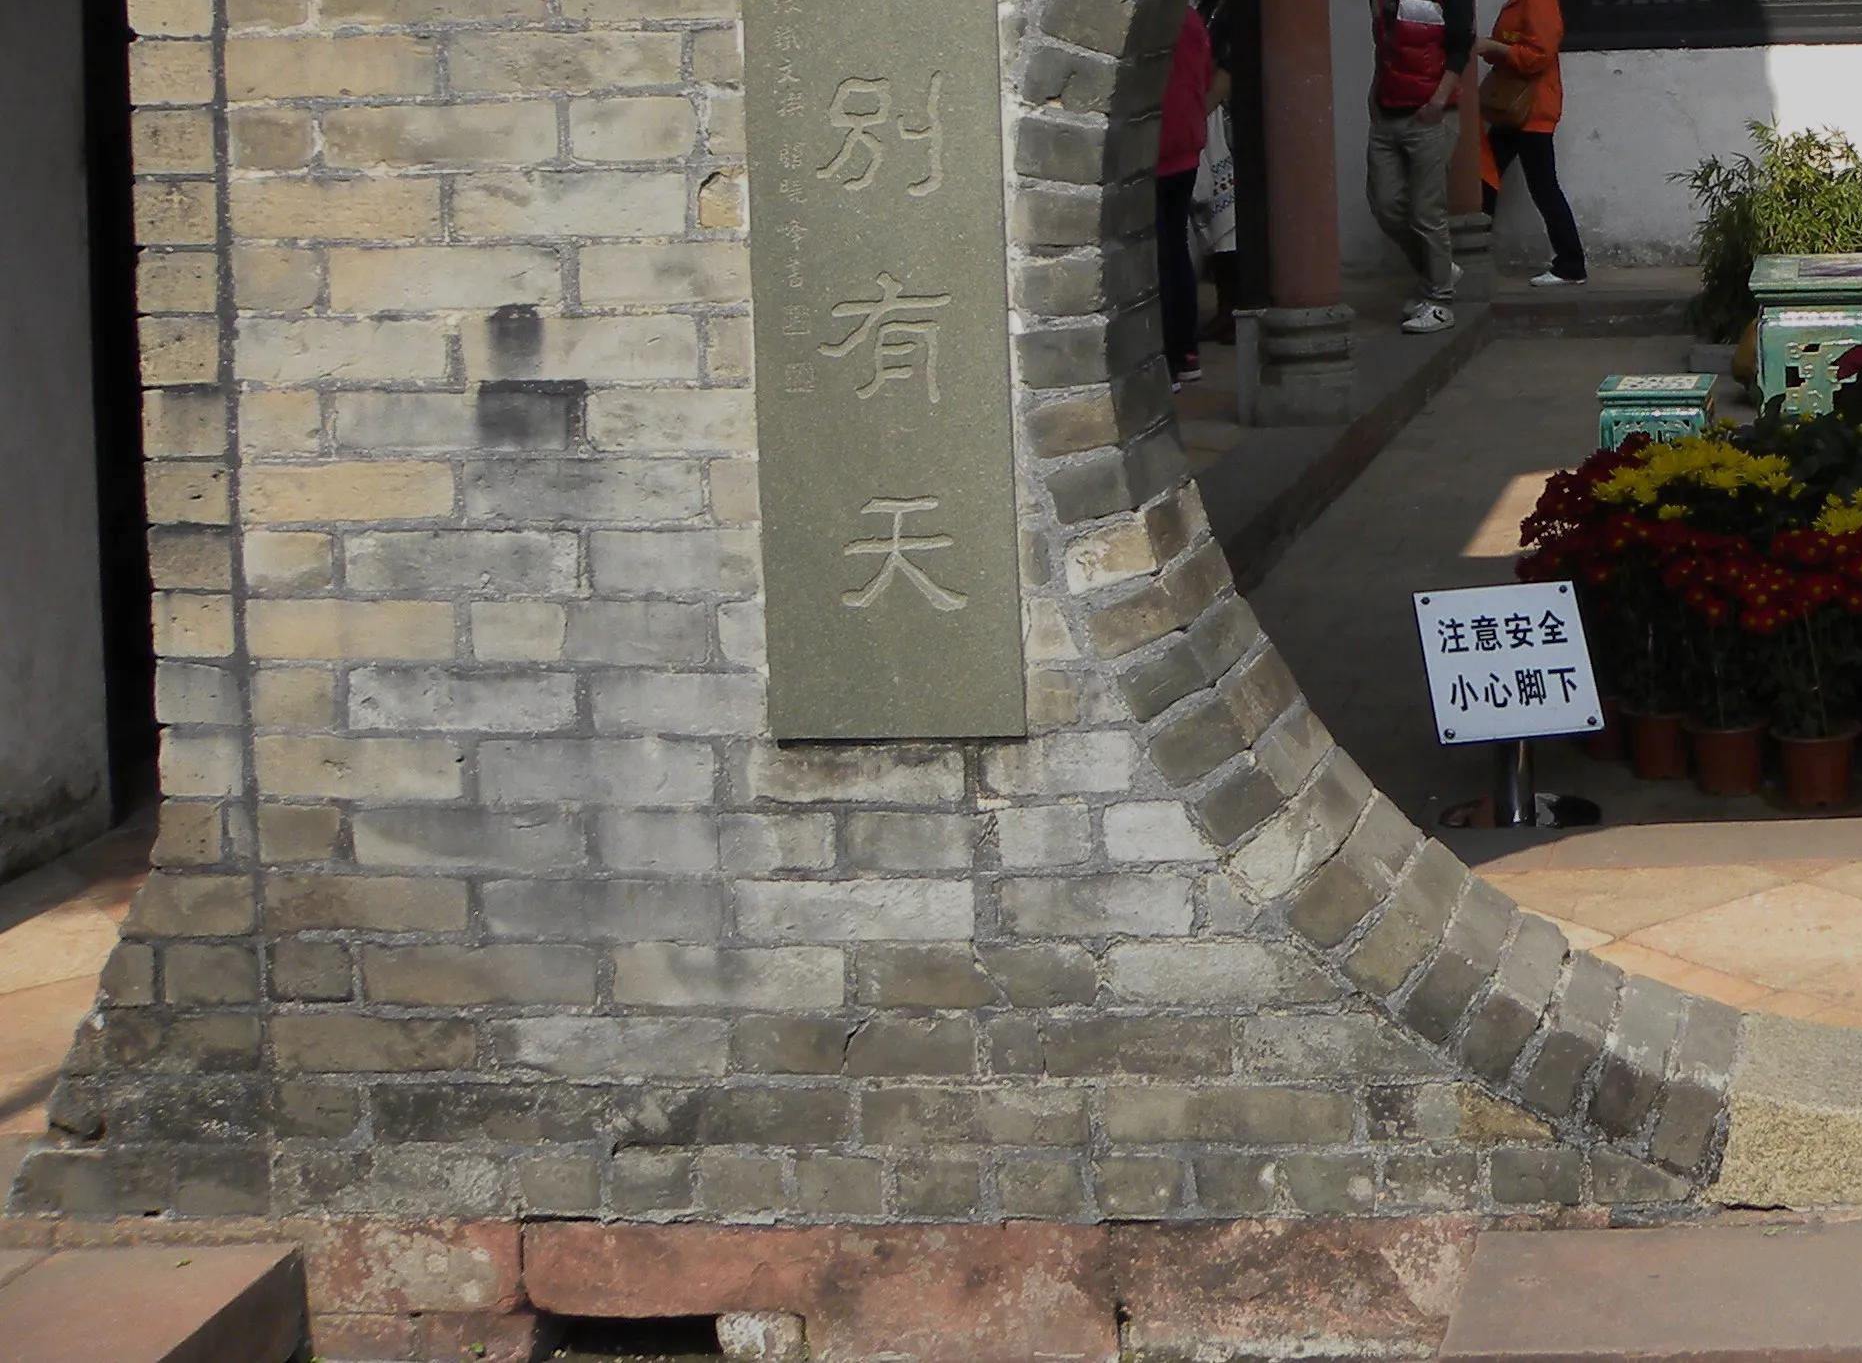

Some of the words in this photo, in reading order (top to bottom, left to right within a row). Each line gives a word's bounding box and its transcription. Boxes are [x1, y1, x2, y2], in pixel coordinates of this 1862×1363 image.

[1437, 609, 1568, 654] 注意安全
[1450, 666, 1578, 712] 小心脚下
